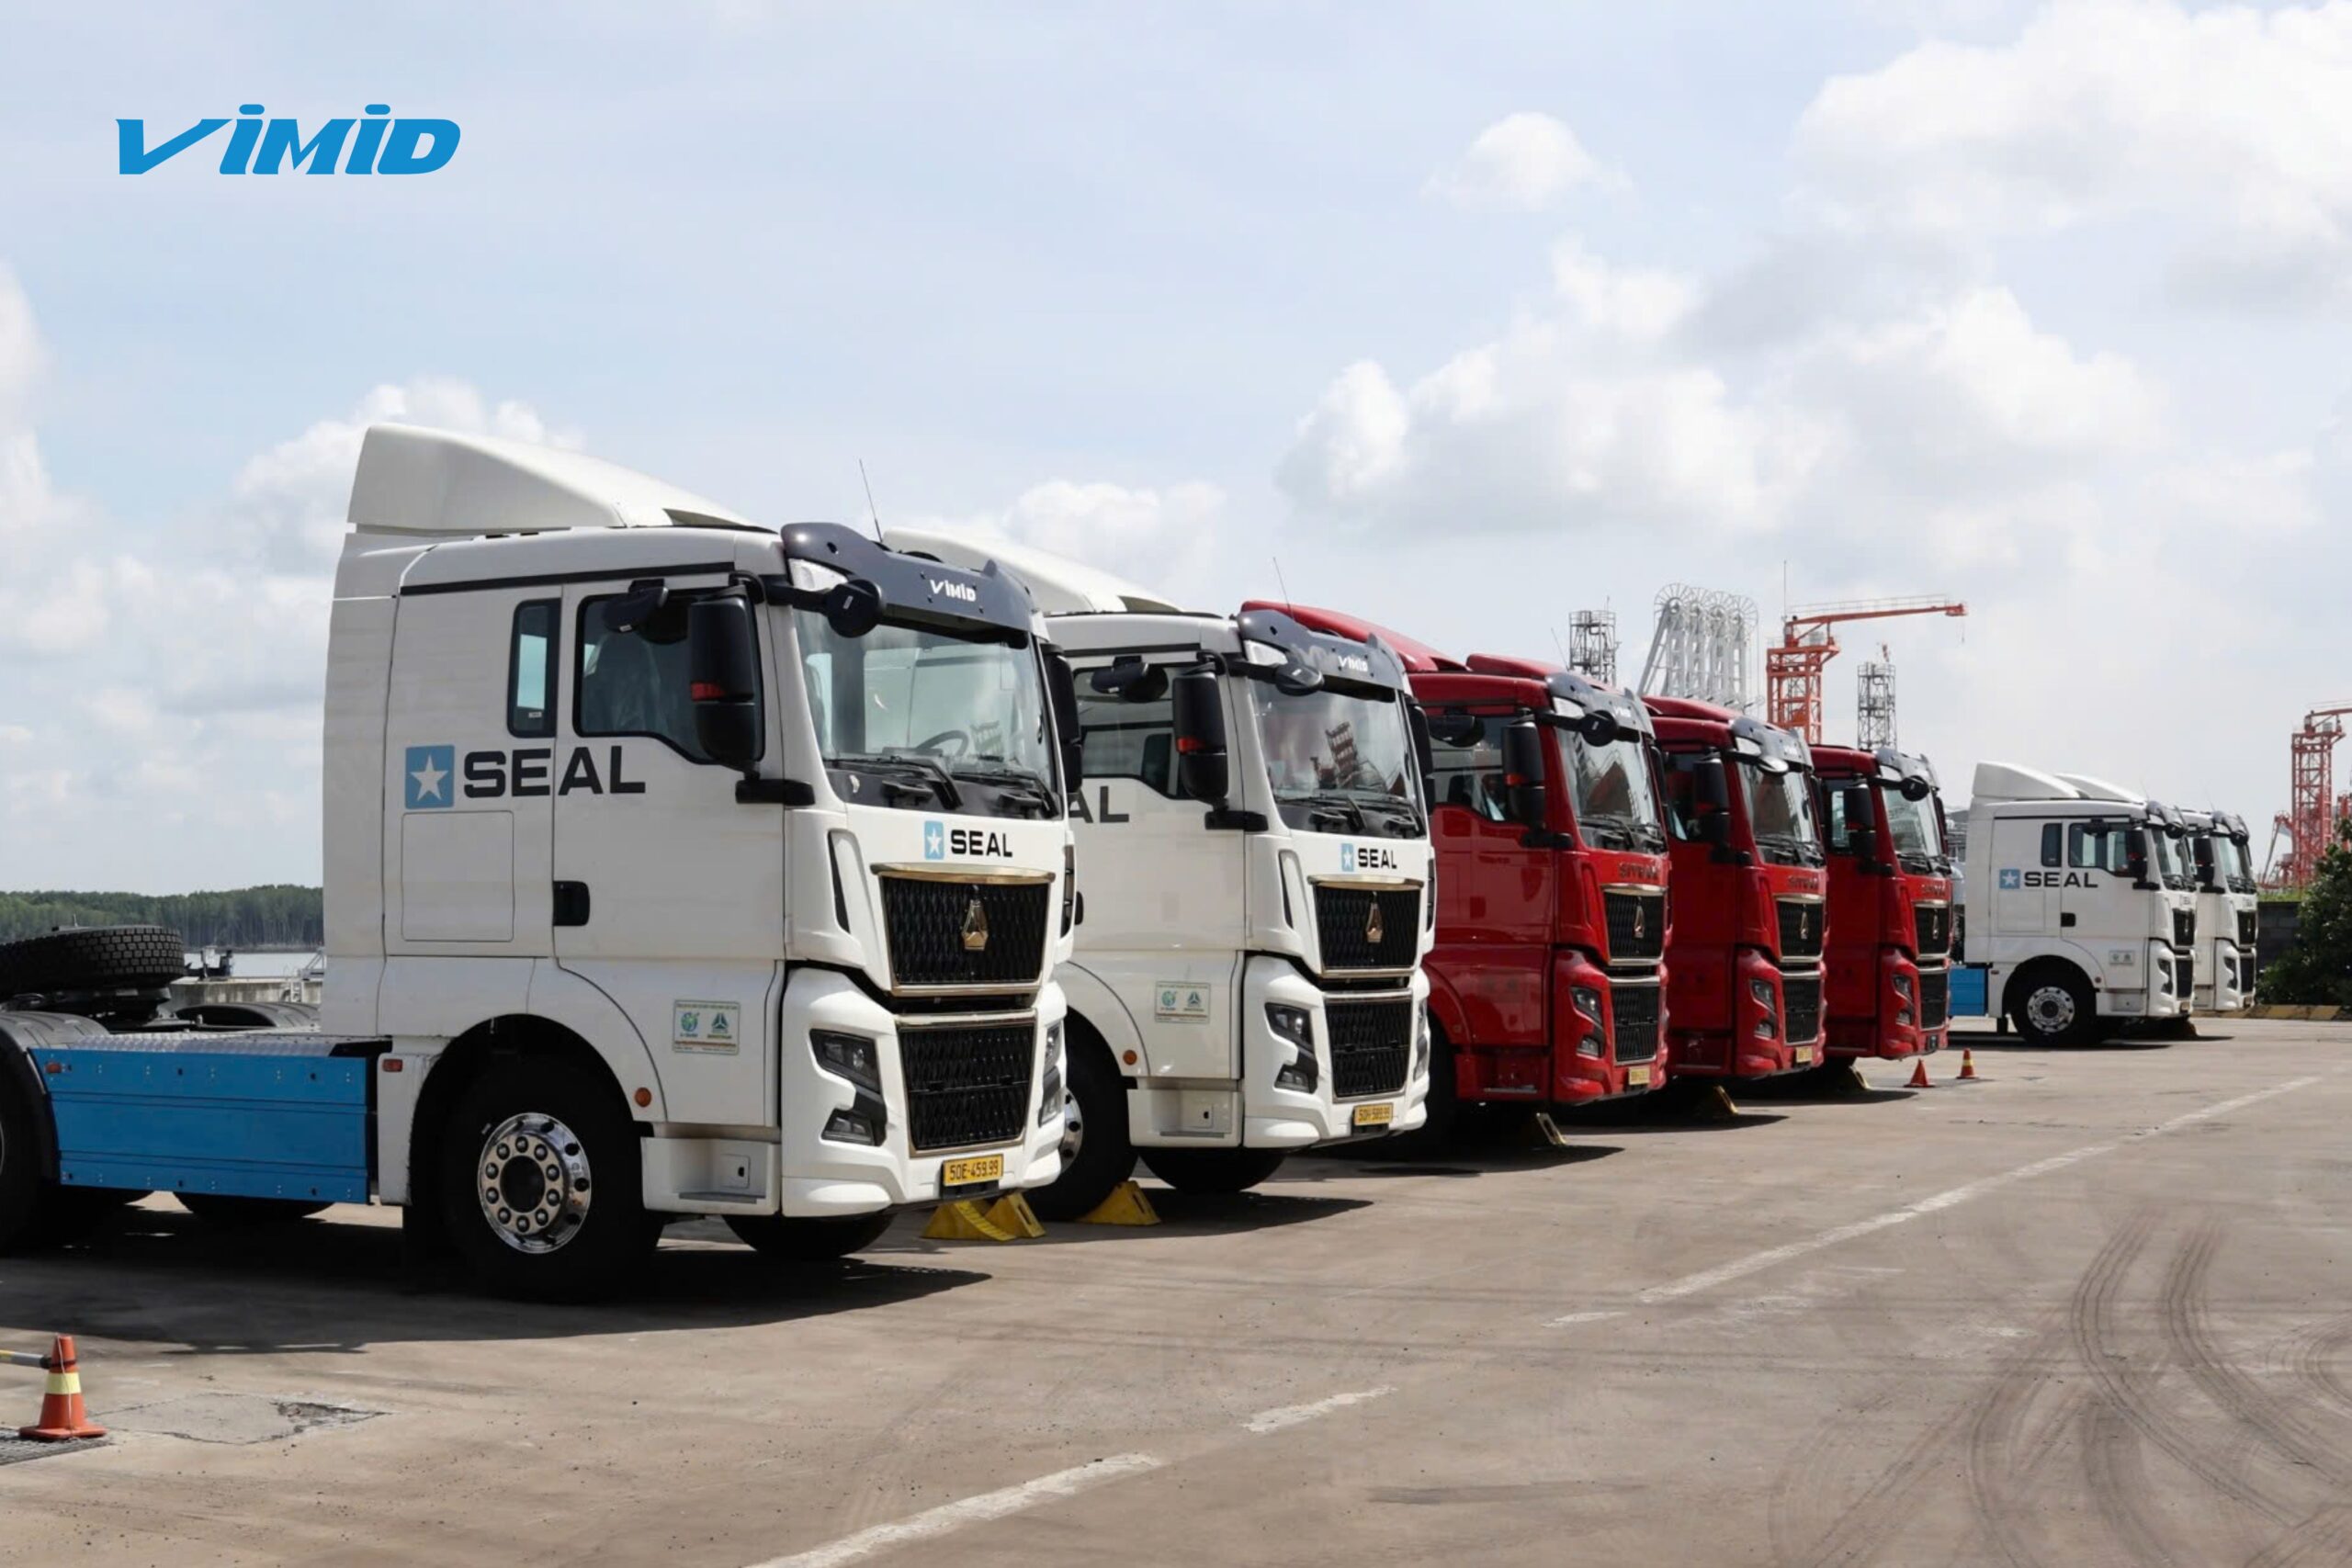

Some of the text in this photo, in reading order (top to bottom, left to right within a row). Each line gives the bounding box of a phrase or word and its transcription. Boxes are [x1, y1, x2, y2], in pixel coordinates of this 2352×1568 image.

[463, 745, 646, 798] SEAL
[1067, 785, 1130, 824] AL
[950, 829, 1013, 858] SEAL
[1358, 848, 1397, 870] SEAL
[2024, 871, 2099, 888] SEAL
[949, 1159, 999, 1180] 50E-459.99
